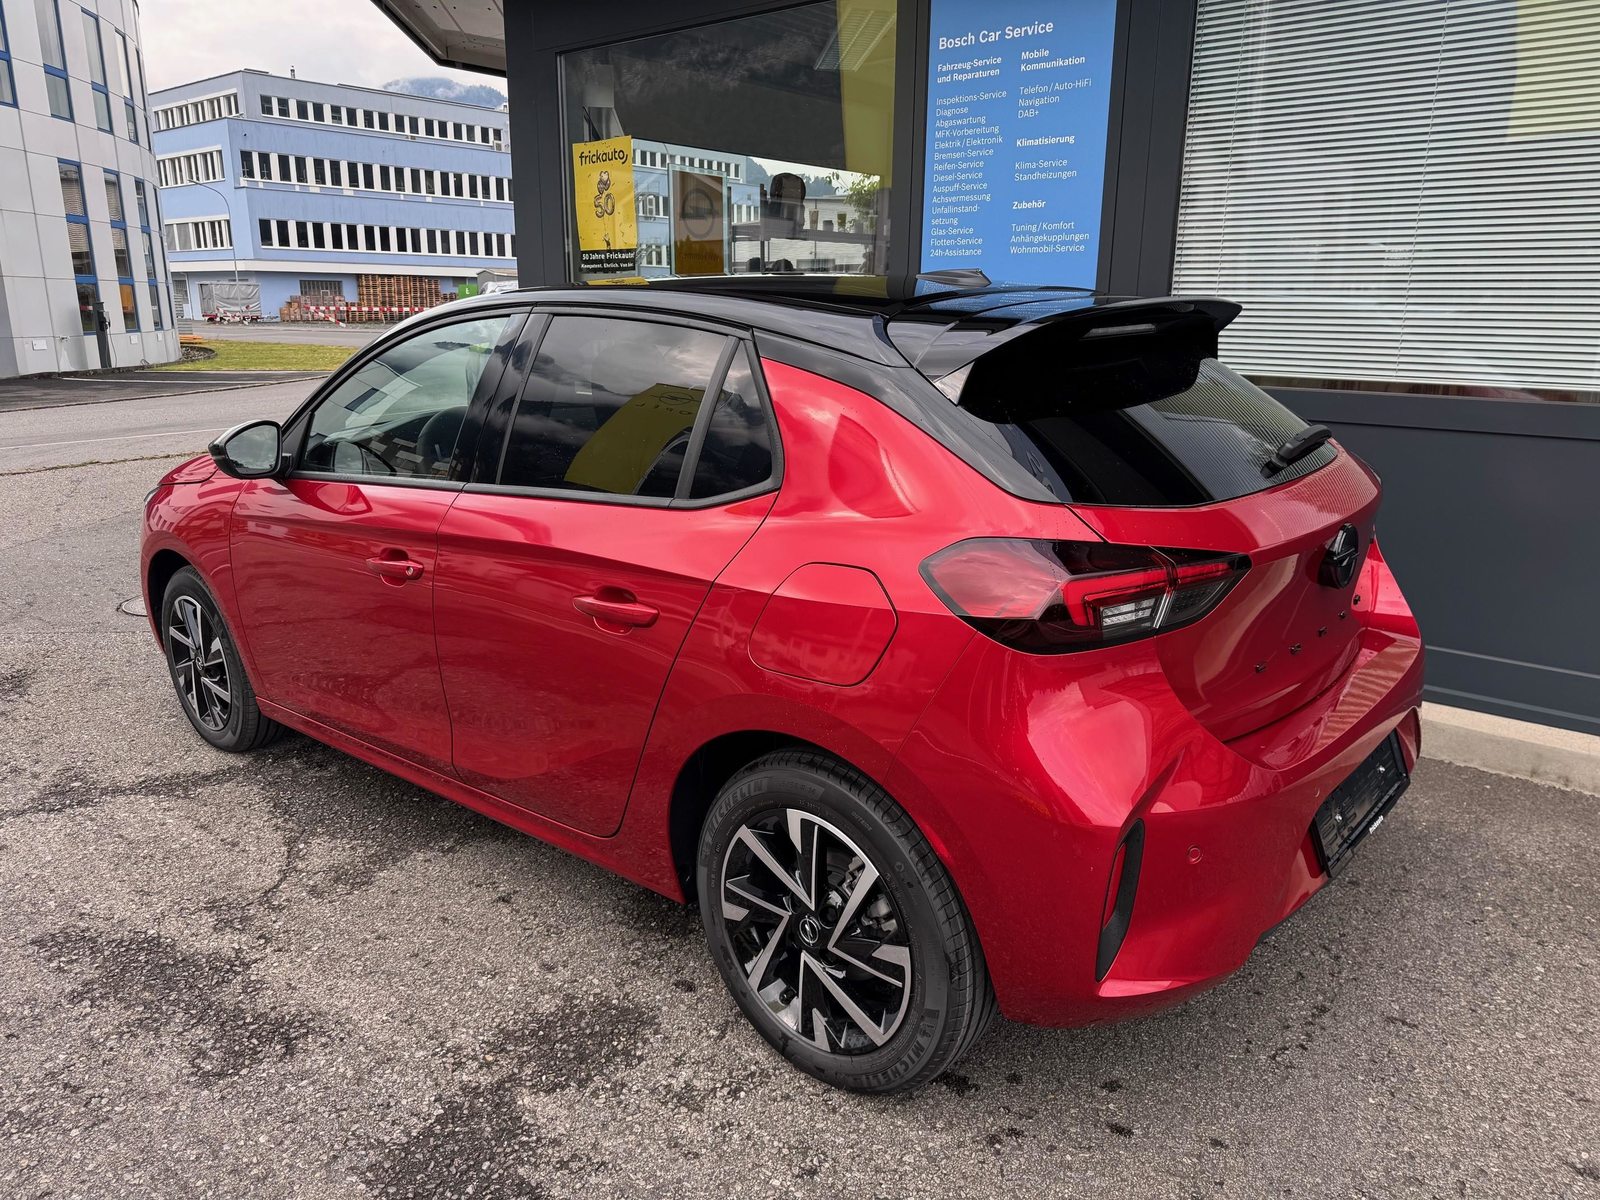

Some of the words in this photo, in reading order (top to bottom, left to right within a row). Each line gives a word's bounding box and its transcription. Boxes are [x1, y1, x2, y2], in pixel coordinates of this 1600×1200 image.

[939, 32, 975, 50] Bosch
[979, 30, 1002, 43] Car
[1004, 21, 1054, 39] Service
[1021, 48, 1050, 60] Mobile
[938, 56, 1002, 72] Fahrzeug-Service
[1020, 56, 1086, 72] Kommunikation
[937, 74, 951, 83] und
[952, 68, 1000, 82] Reparaturen
[1020, 84, 1048, 95] Telefon
[936, 90, 1007, 106] Inspektions-Service
[1018, 95, 1060, 107] Navigation
[936, 106, 969, 116] Diagnose
[1017, 108, 1040, 118] DAB+
[936, 116, 986, 128] Abgaswartung
[935, 126, 1000, 138] MFK-Vorbereitung
[966, 134, 1004, 146] Elektronik
[1016, 135, 1076, 147] Klimatisierung
[934, 148, 994, 160] Bremsen-Service
[934, 160, 984, 171] Reifen-Service
[1014, 158, 1068, 170] Klima-Service
[933, 171, 983, 182] Diesel-Service
[1014, 170, 1077, 181] Standheizungen
[932, 182, 988, 194] Auspuff-Service
[932, 193, 991, 203] Achsvermessung
[594, 192, 615, 218] 50
[931, 204, 980, 214] Unfallinstand-
[1012, 200, 1046, 210] Zubehör
[931, 217, 959, 226] setzung
[1011, 222, 1037, 232] Tuning
[1042, 220, 1075, 230] Komfort
[930, 226, 974, 236] Glas-Service
[930, 238, 982, 246] Flotten-Service
[1010, 232, 1090, 244] Anhängekupplungen
[930, 248, 982, 256] 24h-Assistance
[1009, 244, 1085, 254] Wohnmobil-Service
[590, 252, 605, 260] Jahre
